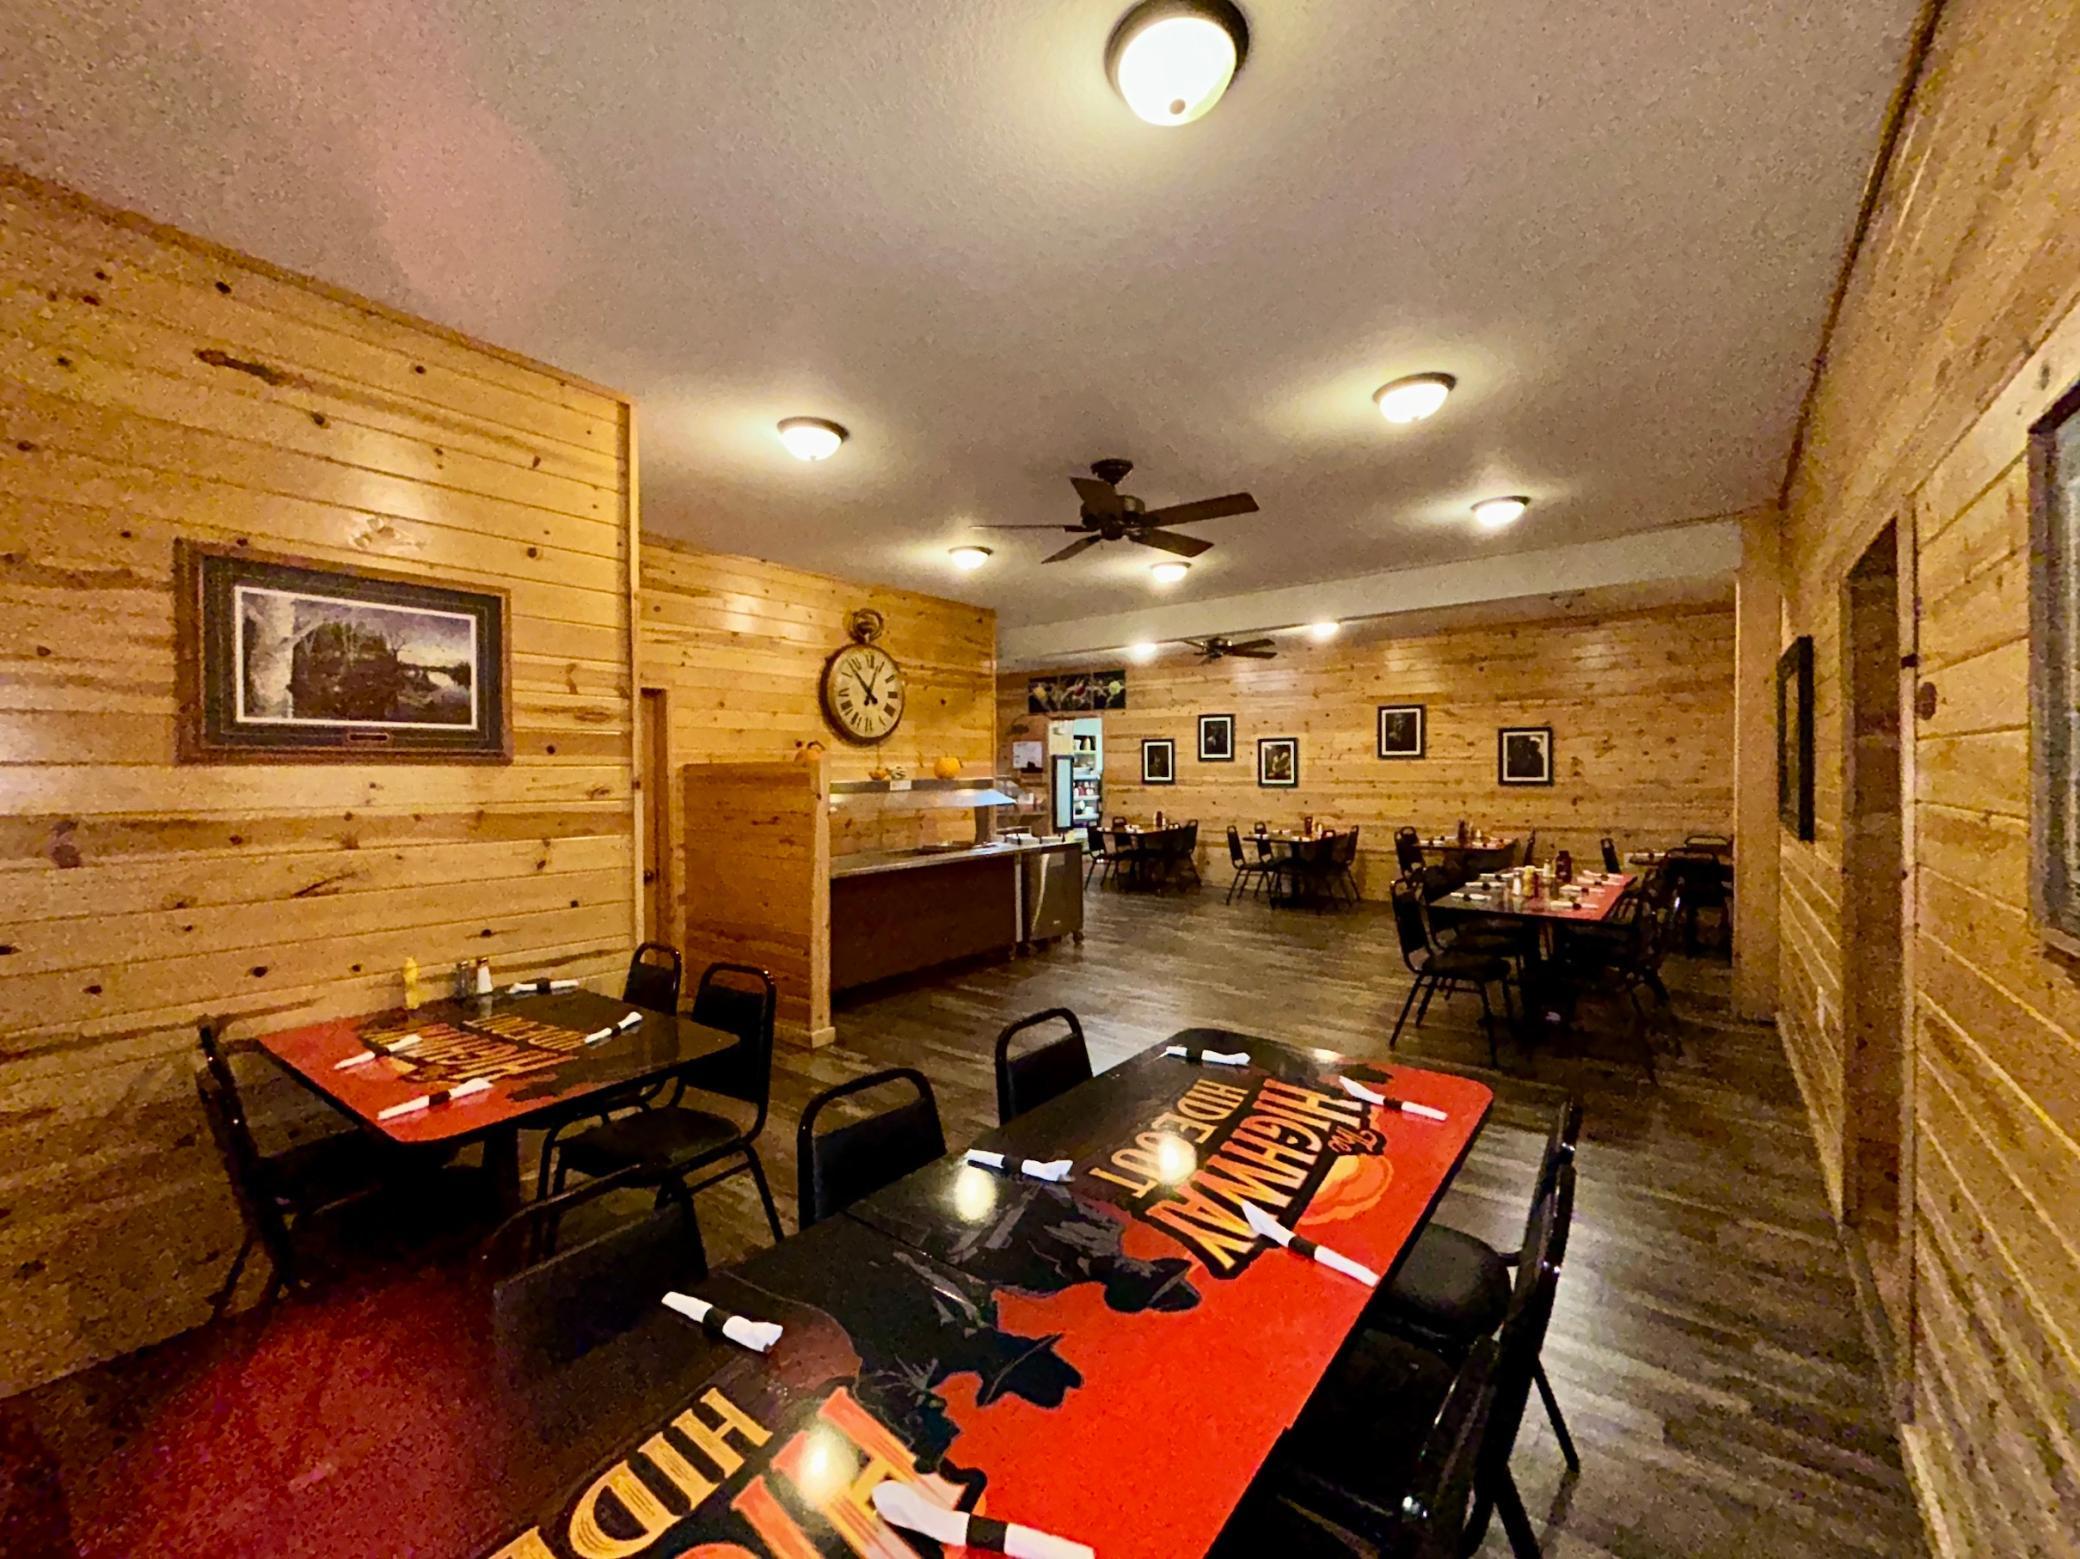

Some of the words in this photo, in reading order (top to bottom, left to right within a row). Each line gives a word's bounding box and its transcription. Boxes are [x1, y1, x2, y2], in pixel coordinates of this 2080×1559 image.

[1089, 1078, 1249, 1198] HIDEOUT
[1146, 1078, 1362, 1269] HIGHWAY
[1328, 1125, 1378, 1152] The
